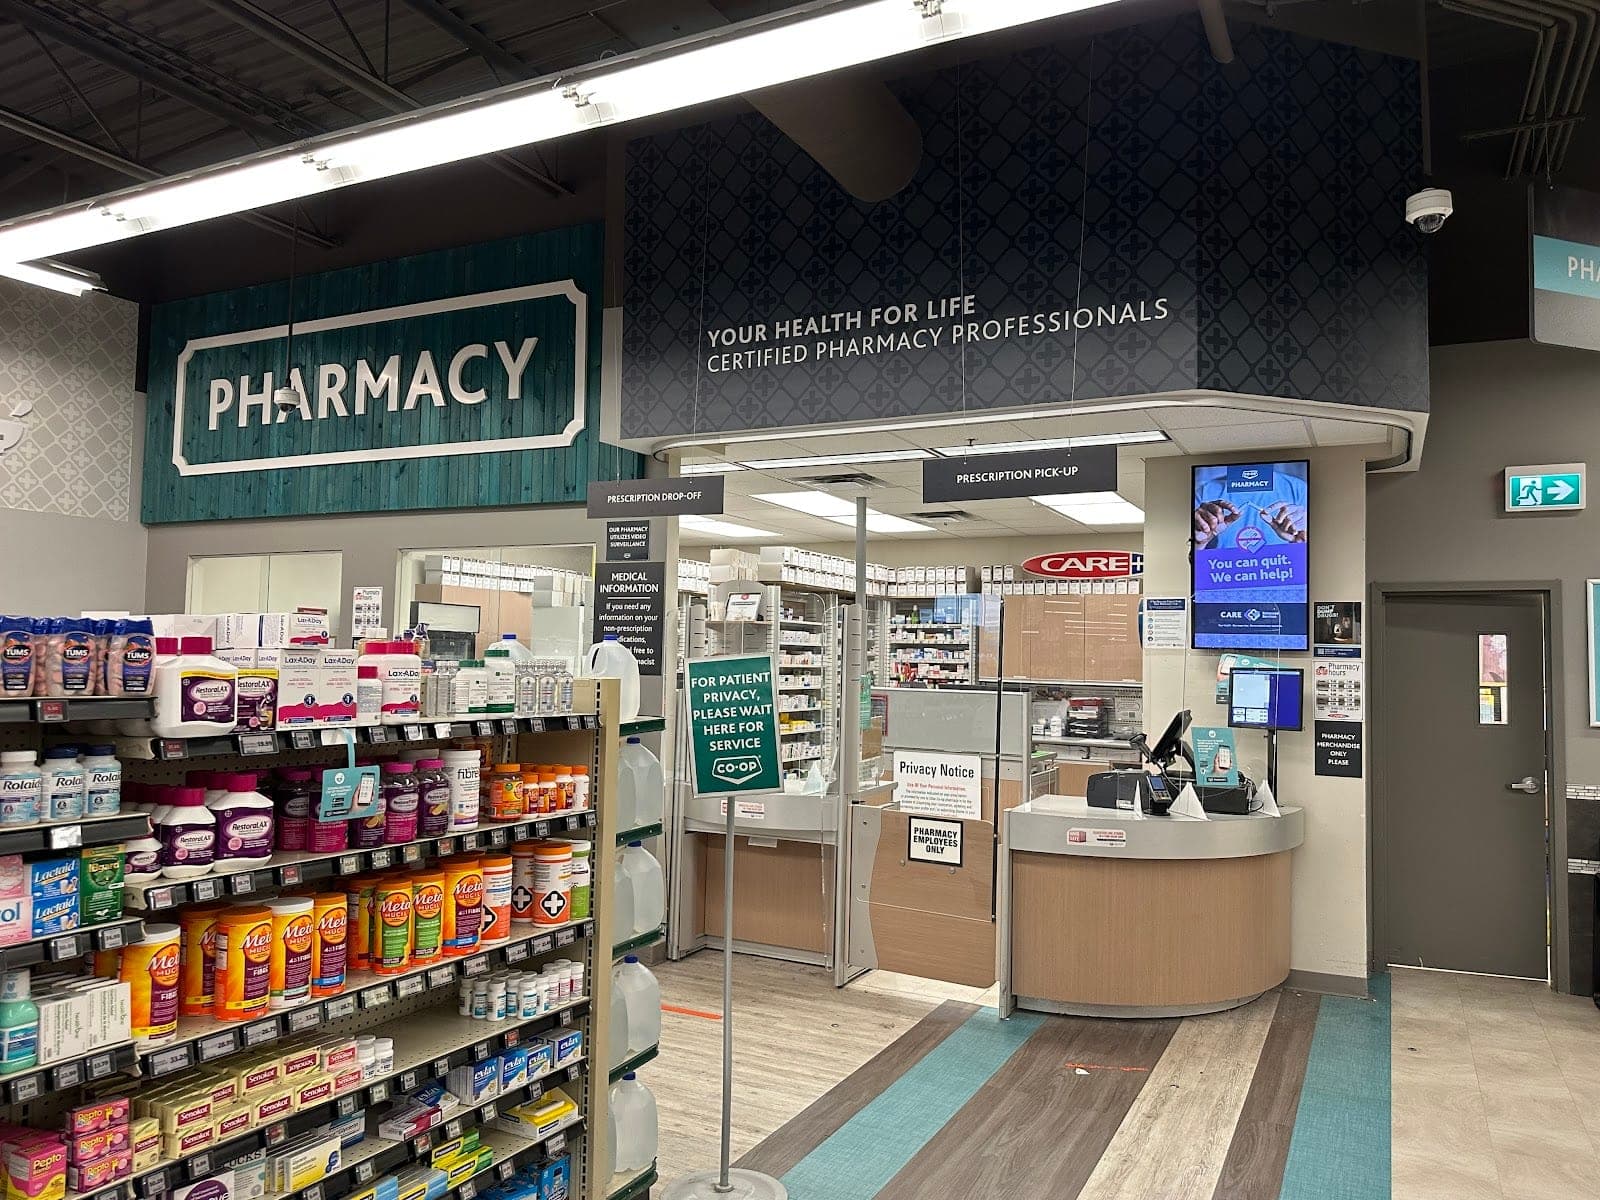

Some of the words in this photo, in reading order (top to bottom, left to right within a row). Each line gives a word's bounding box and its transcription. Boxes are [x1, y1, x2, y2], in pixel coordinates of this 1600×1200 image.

[1567, 256, 1600, 282] PH
[708, 324, 767, 348] YOUR
[775, 310, 862, 339] HEALTH
[870, 303, 918, 327] FOR
[927, 294, 976, 320] LIFE
[707, 344, 808, 373] CERTIFIED
[816, 326, 943, 360] PHARMACY
[952, 298, 1168, 344] PROFESSIONALS
[208, 336, 539, 430] PHARMACY
[956, 469, 1032, 483] PRESCRIPTION
[1034, 466, 1079, 478] PICK-UP
[1231, 480, 1269, 488] PHARMACY
[607, 493, 660, 503] PRESCRIPTION
[661, 491, 702, 501] DROP-OFF
[1040, 556, 1129, 572] CARE
[1208, 559, 1232, 570] You
[1235, 558, 1258, 568] can
[1261, 554, 1292, 569] quit.
[611, 572, 647, 581] MEDICAL
[1210, 572, 1232, 583] We
[1234, 572, 1257, 581] can
[1260, 567, 1293, 581] help!
[599, 584, 659, 593] INFORMATION
[640, 604, 651, 612] any
[603, 625, 652, 633] non-prescription
[6, 649, 29, 657] TUMS
[65, 649, 88, 657] TUMS
[1328, 663, 1360, 671] Pharmacy
[691, 676, 716, 688] FOR
[719, 671, 770, 686] PATIENT
[195, 685, 228, 693] RestoraLAX
[703, 689, 760, 703] PRIVACY,
[693, 707, 737, 720] PLEASE
[740, 704, 772, 716] WAIT
[703, 723, 736, 735] HERE
[739, 721, 764, 733] FOR
[709, 738, 761, 751] SERVICE
[1316, 741, 1360, 749] MERCHANDISE
[1328, 758, 1349, 766] PLEASE
[899, 761, 937, 778] Privacy
[940, 763, 975, 778] Notice
[232, 821, 268, 831] RestoraLAX
[180, 835, 211, 843] RestoraLAX
[914, 827, 957, 839] PHARMACY
[913, 836, 958, 848] EMPLOYEES
[926, 845, 945, 854] ONLY
[35, 860, 75, 883] Lactaid
[88, 861, 120, 873] IBgard
[413, 893, 443, 905] Meta
[35, 896, 75, 919] Lactaid
[381, 901, 411, 912] Meta
[331, 1050, 354, 1062] Senokot
[287, 1058, 315, 1072] Senokot
[248, 1069, 276, 1083] Senokot
[336, 1073, 360, 1085] Senokot
[302, 1084, 330, 1098] Senokot
[261, 1098, 289, 1112] Senokot
[77, 1108, 103, 1121] Pepto
[180, 1106, 209, 1120] Senokot
[221, 1115, 247, 1129] Senokot
[80, 1135, 104, 1149] Pepto
[184, 1130, 210, 1144] Senokot
[87, 1161, 110, 1175] Pepto
